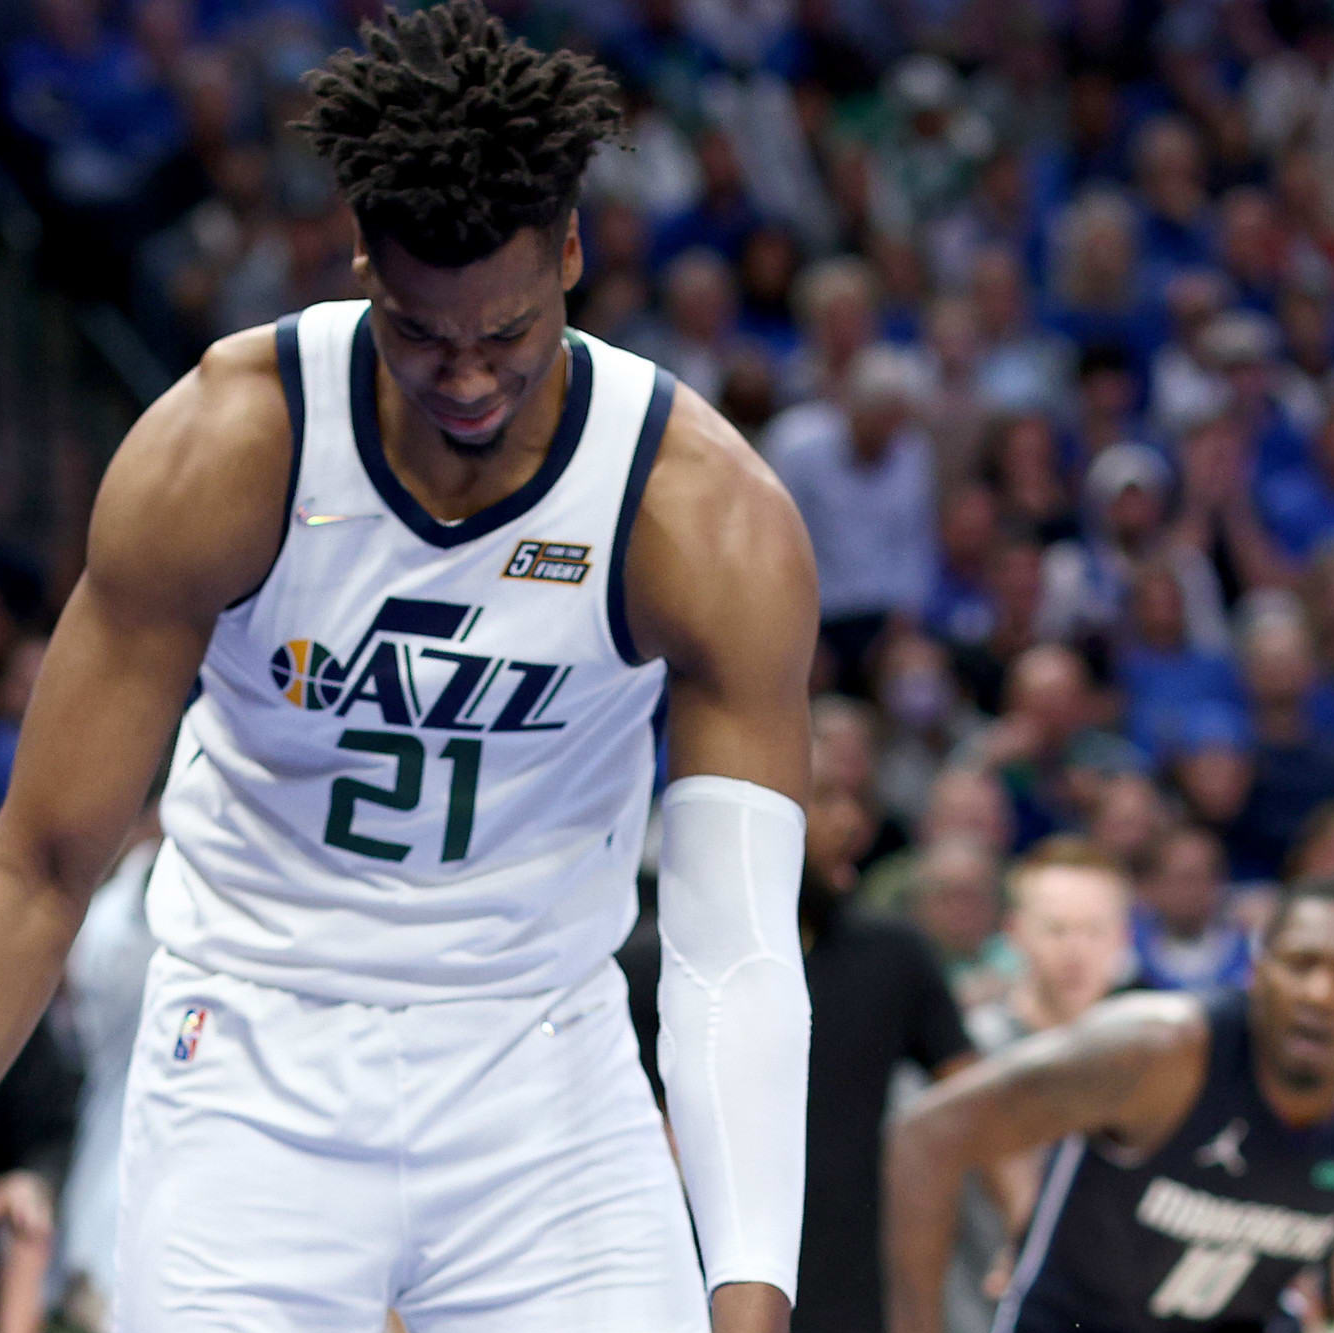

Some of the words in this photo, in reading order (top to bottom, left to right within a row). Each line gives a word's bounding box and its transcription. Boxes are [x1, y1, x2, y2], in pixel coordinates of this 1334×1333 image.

[509, 543, 540, 577] 5
[271, 596, 574, 733] JAZZ
[323, 729, 484, 862] 21
